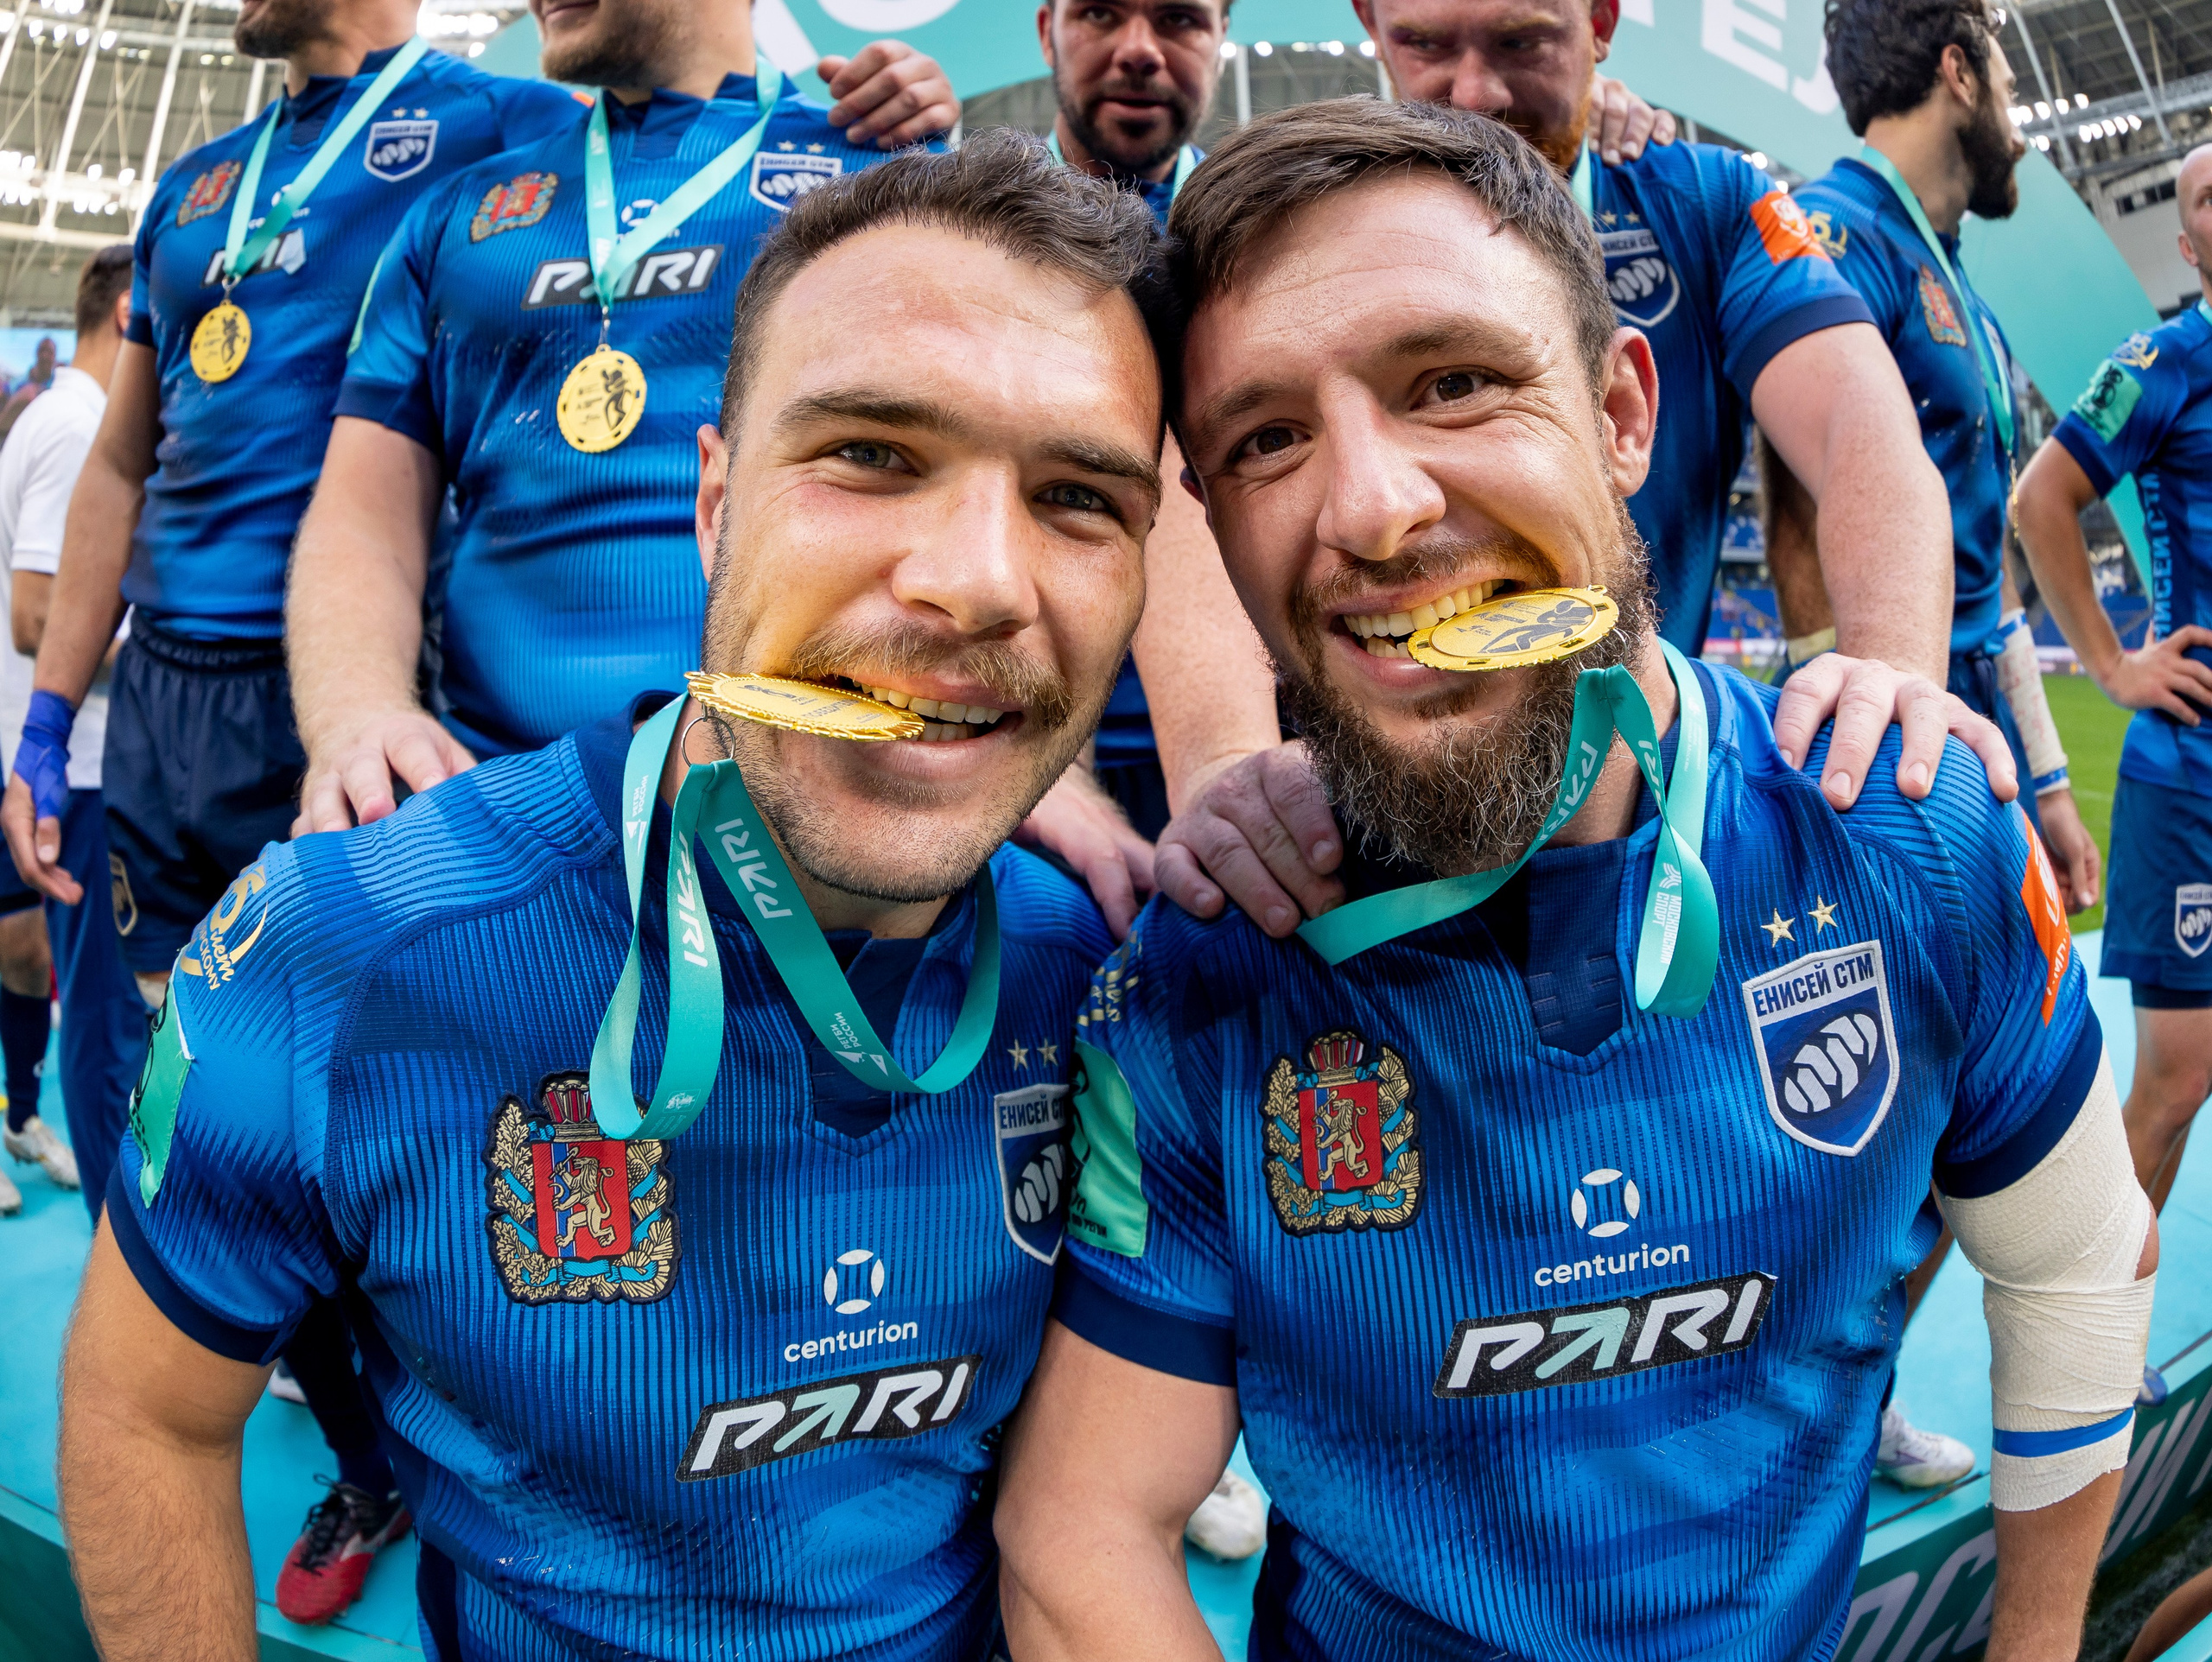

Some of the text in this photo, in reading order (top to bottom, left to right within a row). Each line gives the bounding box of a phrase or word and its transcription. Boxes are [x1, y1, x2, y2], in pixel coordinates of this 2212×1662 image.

[632, 786, 641, 818] РЕГБИ
[638, 775, 649, 814] РОССИИ
[715, 818, 793, 919] PARI
[1652, 891, 1670, 927] СПОРТ
[1752, 952, 1874, 1018] ЕНИСЕЙ СТМ
[830, 1024, 852, 1050] РЕГБИ
[834, 1012, 862, 1048] РОССИИ
[999, 1093, 1065, 1130] ЕНИСЕЙ СТ
[1534, 1242, 1690, 1287] centurion
[784, 1320, 918, 1363] centurion
[1446, 1279, 1763, 1389] PARI
[690, 1363, 969, 1472] PARI
